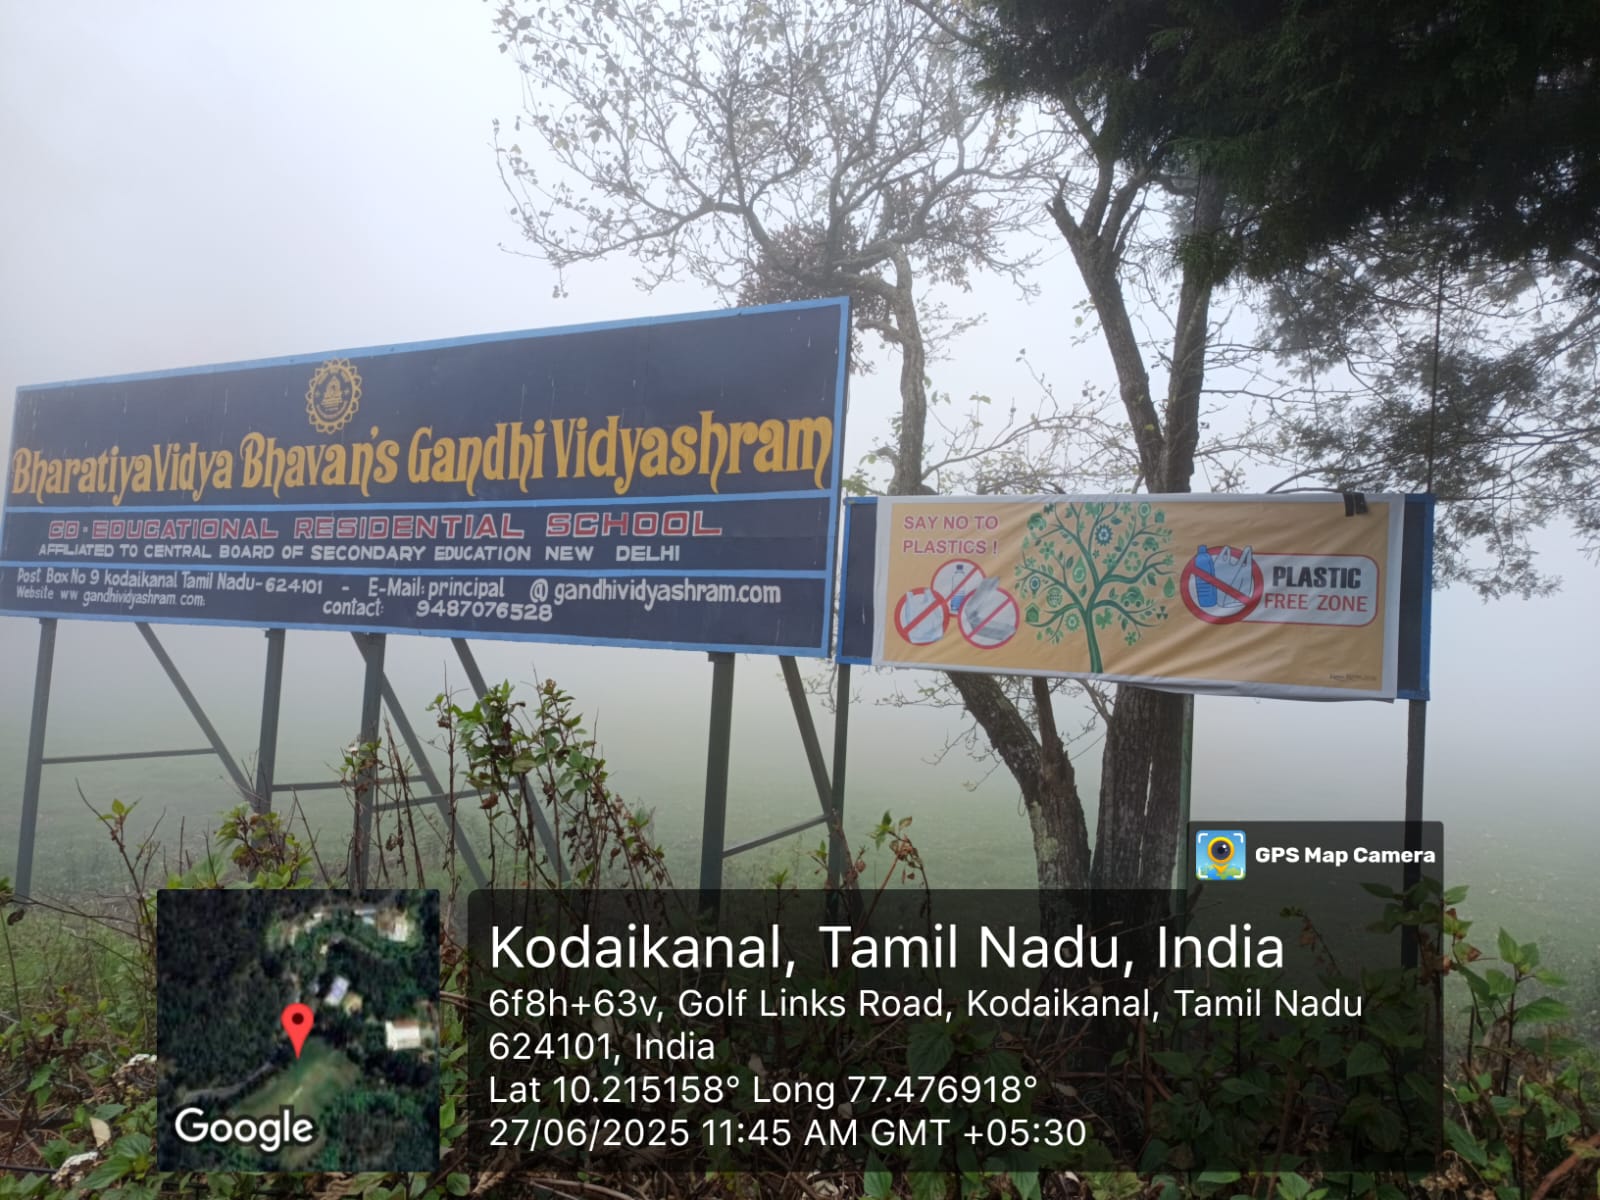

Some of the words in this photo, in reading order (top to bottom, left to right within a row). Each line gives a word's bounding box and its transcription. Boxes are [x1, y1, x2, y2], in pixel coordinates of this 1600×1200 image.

[239, 425, 400, 498] Bhavan's
[408, 419, 547, 497] Gandhi
[550, 410, 833, 496] Vidyashram
[294, 513, 524, 539] RESIDENTIAL
[546, 510, 723, 539] SCHOOL
[903, 515, 938, 530] SAY
[943, 515, 969, 530] NO
[974, 515, 999, 530] TO
[38, 543, 115, 558] AFFILIATED
[119, 544, 138, 558] TO
[143, 544, 212, 559] CENTRAL
[219, 545, 275, 559] BOARD
[281, 545, 304, 560] OF
[310, 545, 426, 562] SECONDARY
[434, 545, 531, 562] EDUCATION
[545, 545, 594, 561] NEW
[615, 545, 680, 562] DELHI
[17, 567, 42, 583] Post
[46, 567, 69, 584] Box
[70, 568, 86, 584] No
[90, 569, 100, 585] 9
[104, 570, 178, 588] kodaikanal
[181, 571, 213, 589] Tamil
[428, 576, 504, 600] principal
[1272, 566, 1363, 589] PLASTIC
[16, 585, 54, 600] Website
[1264, 593, 1308, 610] FREE
[1316, 594, 1368, 612] ZONE
[416, 600, 553, 622] 9487076528
